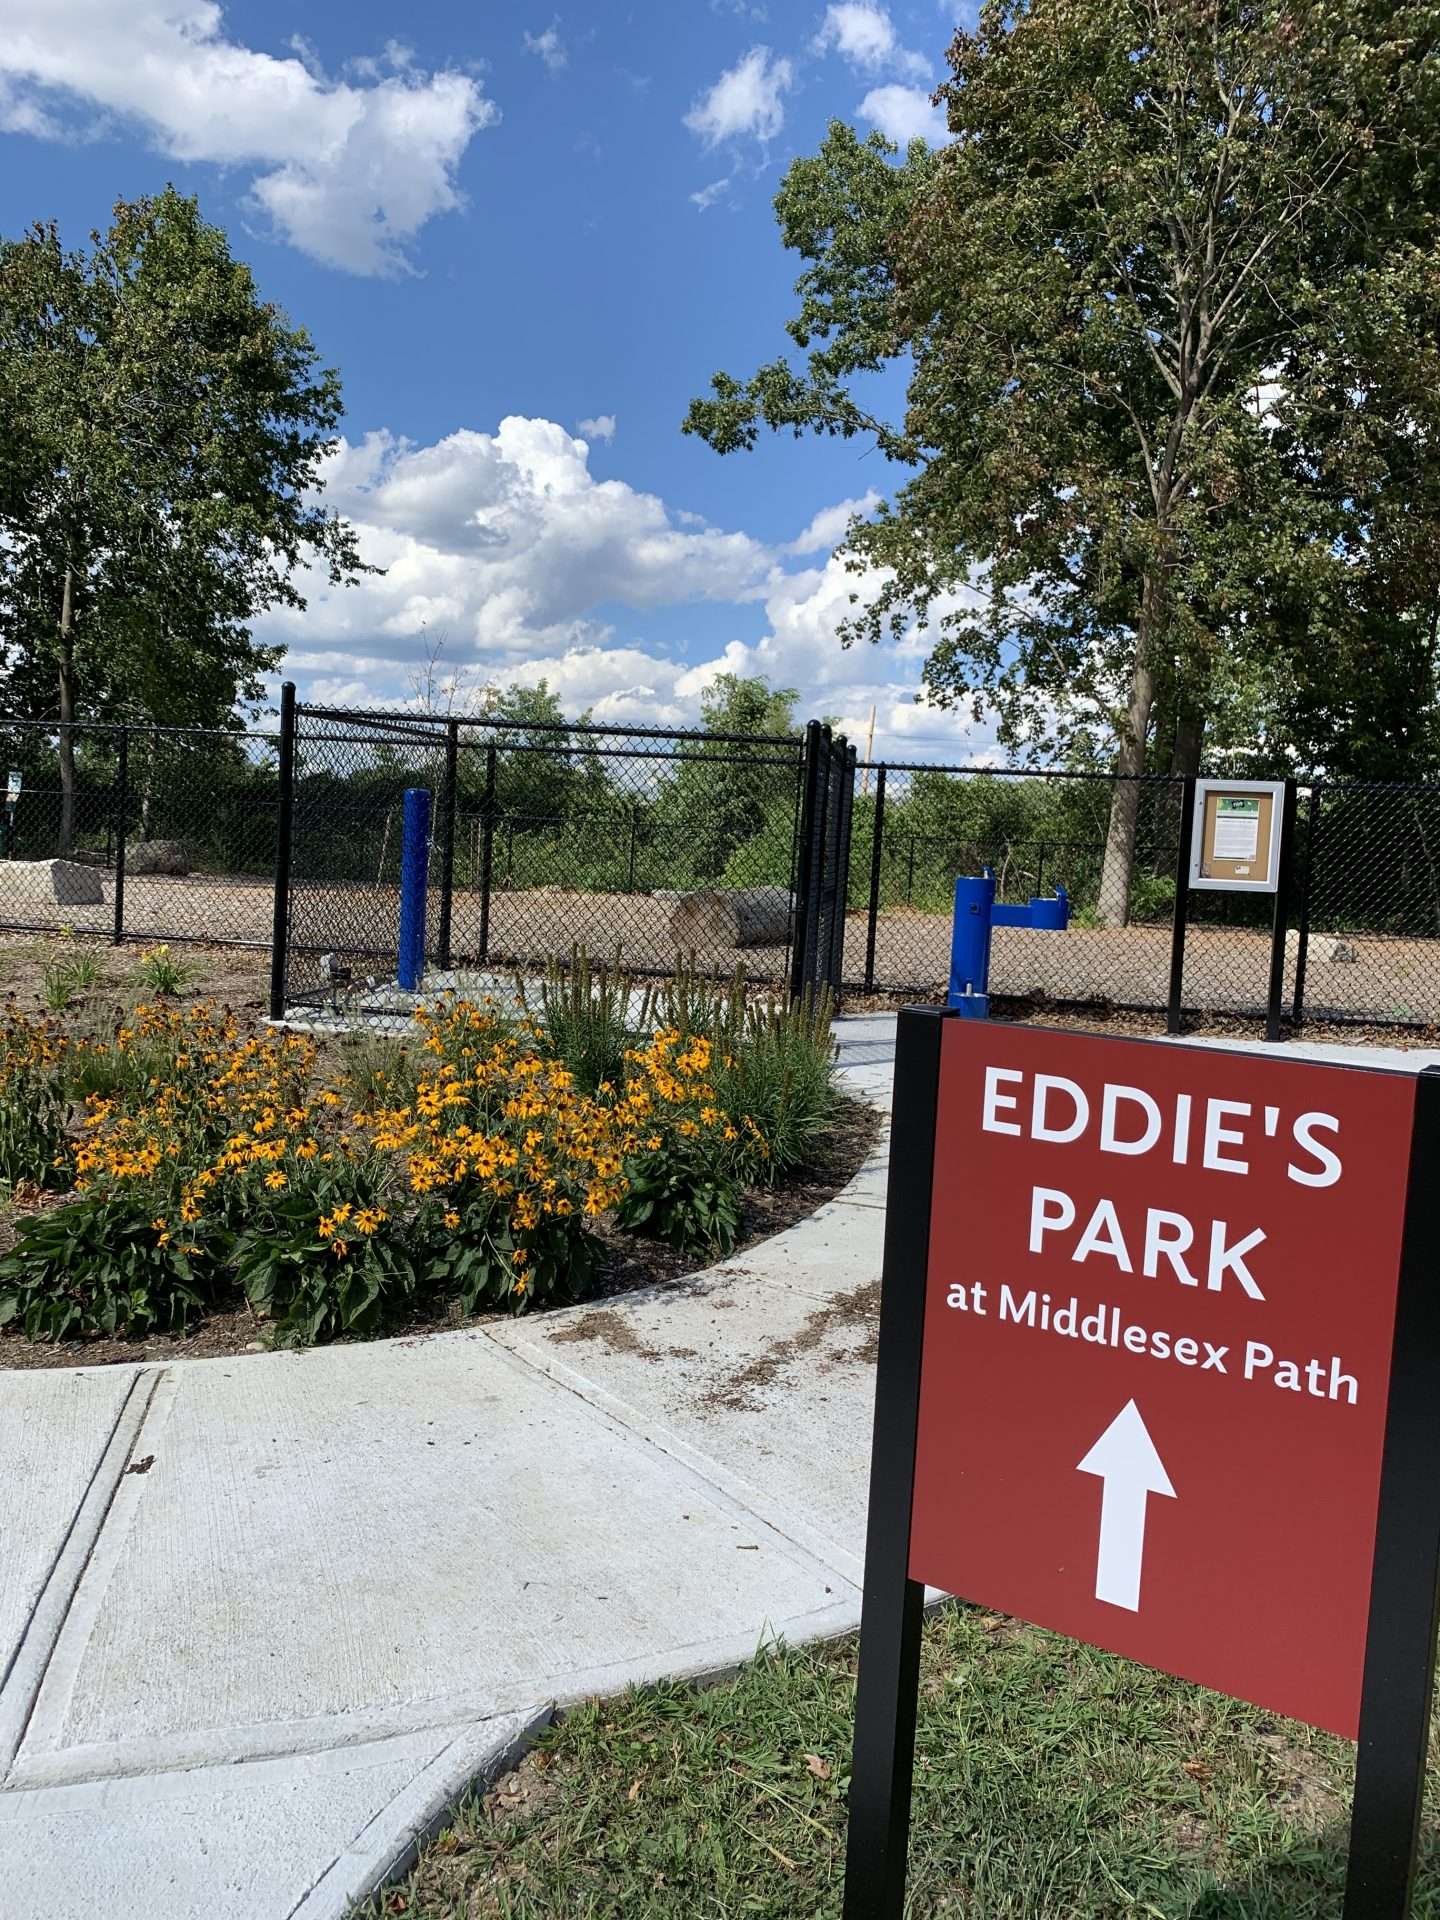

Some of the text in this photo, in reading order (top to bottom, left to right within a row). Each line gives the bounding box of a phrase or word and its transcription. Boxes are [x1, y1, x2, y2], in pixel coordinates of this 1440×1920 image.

[982, 1066, 1343, 1188] EDDIE'S
[1028, 1186, 1267, 1302] PARK
[946, 1281, 1359, 1405] at Middlesex Path
